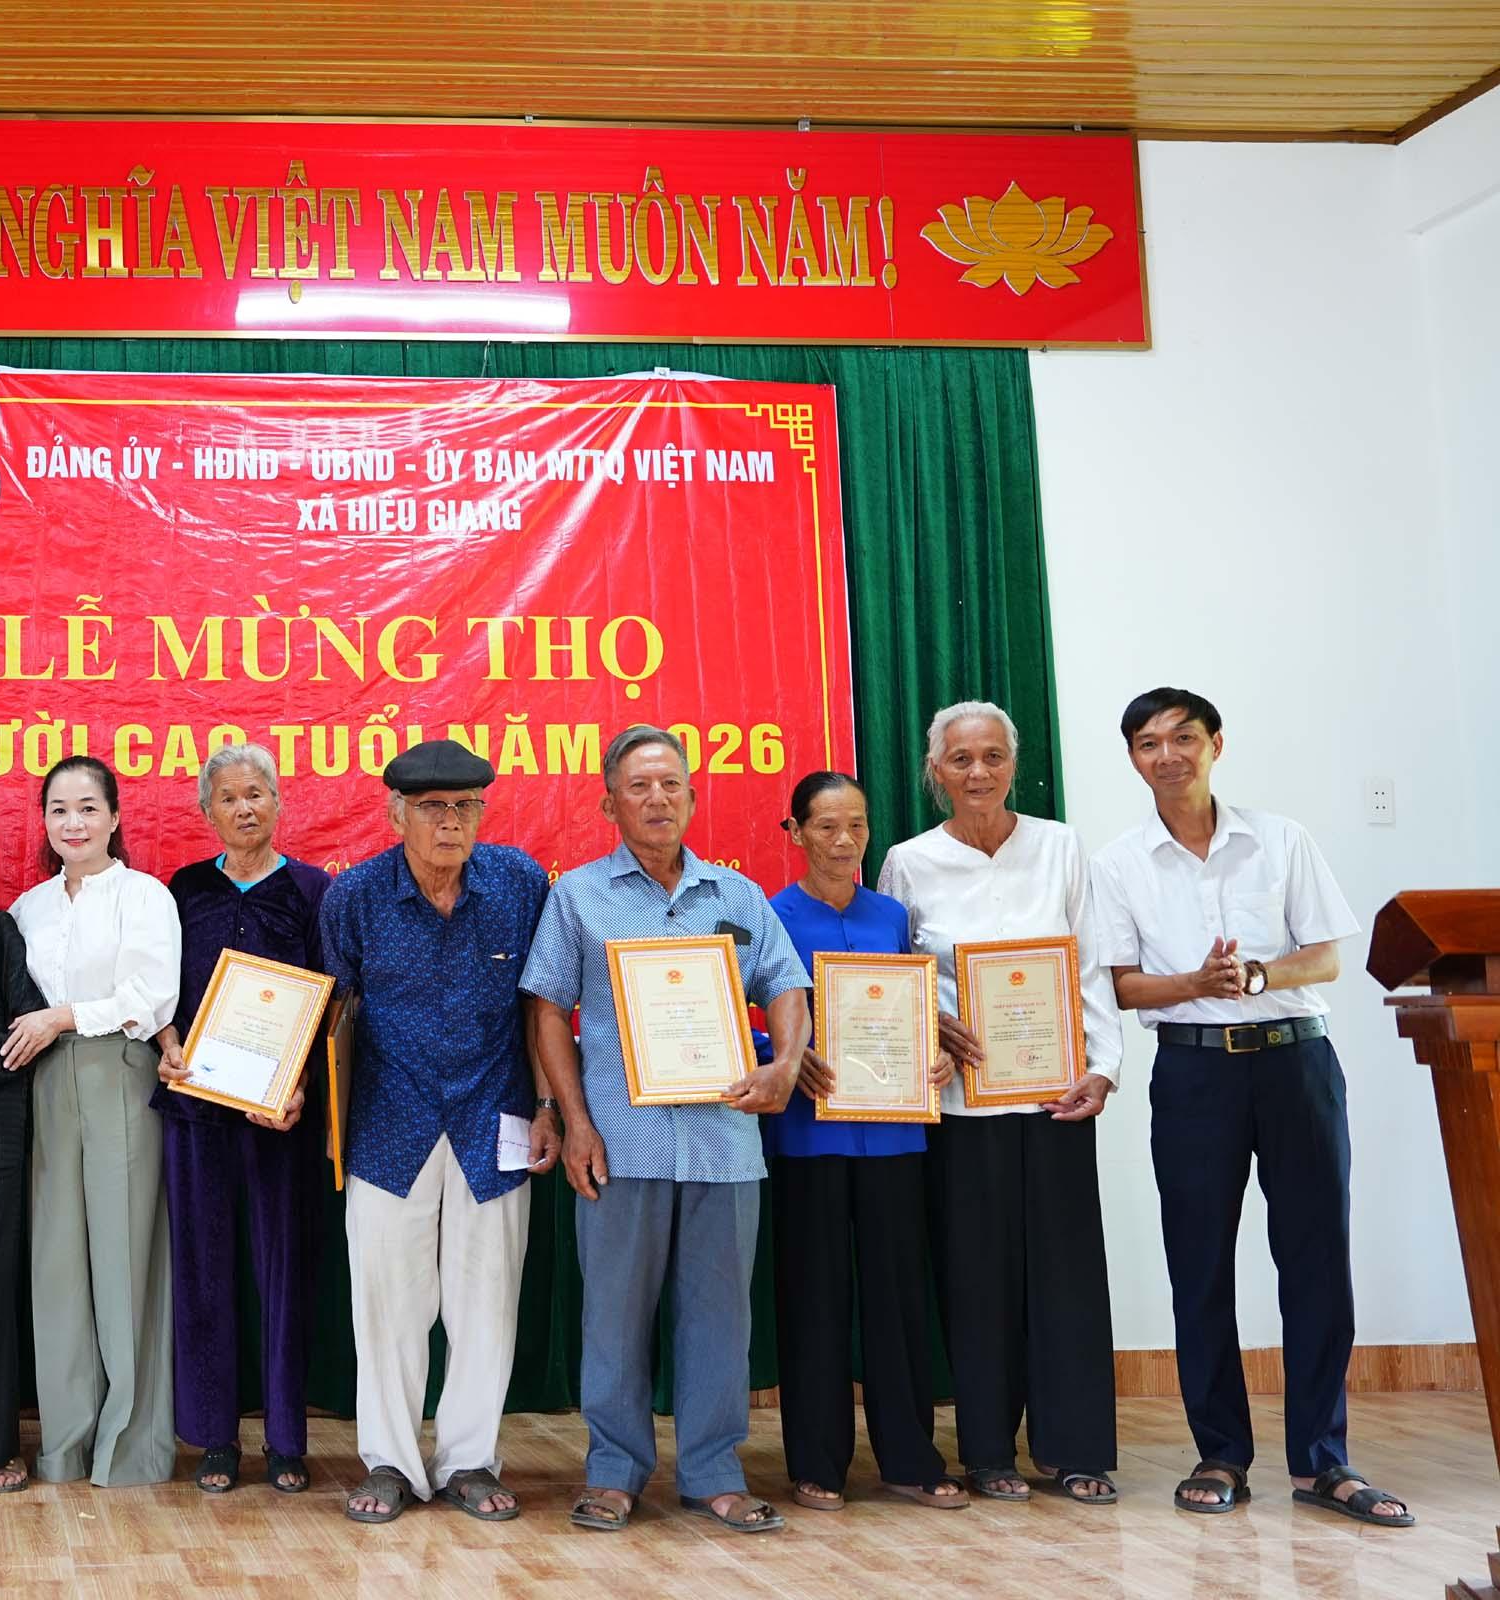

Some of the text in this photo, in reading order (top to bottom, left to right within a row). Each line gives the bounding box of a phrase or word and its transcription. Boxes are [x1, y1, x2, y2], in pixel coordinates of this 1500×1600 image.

[205, 160, 360, 304] VIỆT
[379, 189, 524, 283] NAM
[534, 166, 722, 286] MUÔN
[731, 168, 898, 289] NĂM!
[26, 435, 112, 479] ĐẢNG
[122, 436, 162, 480] ỦY
[194, 447, 279, 480] HĐND
[311, 448, 395, 481] UBND
[426, 438, 465, 482] ỦY
[474, 450, 537, 482] BAN
[547, 449, 626, 485] MTTQ
[633, 442, 697, 489] VIỆT
[706, 450, 775, 482] NAM
[296, 492, 339, 531] XÃ
[426, 499, 522, 531] GIANG
[145, 594, 444, 683] MỪNG
[467, 615, 665, 700] THỌ
[627, 723, 786, 775] 026
